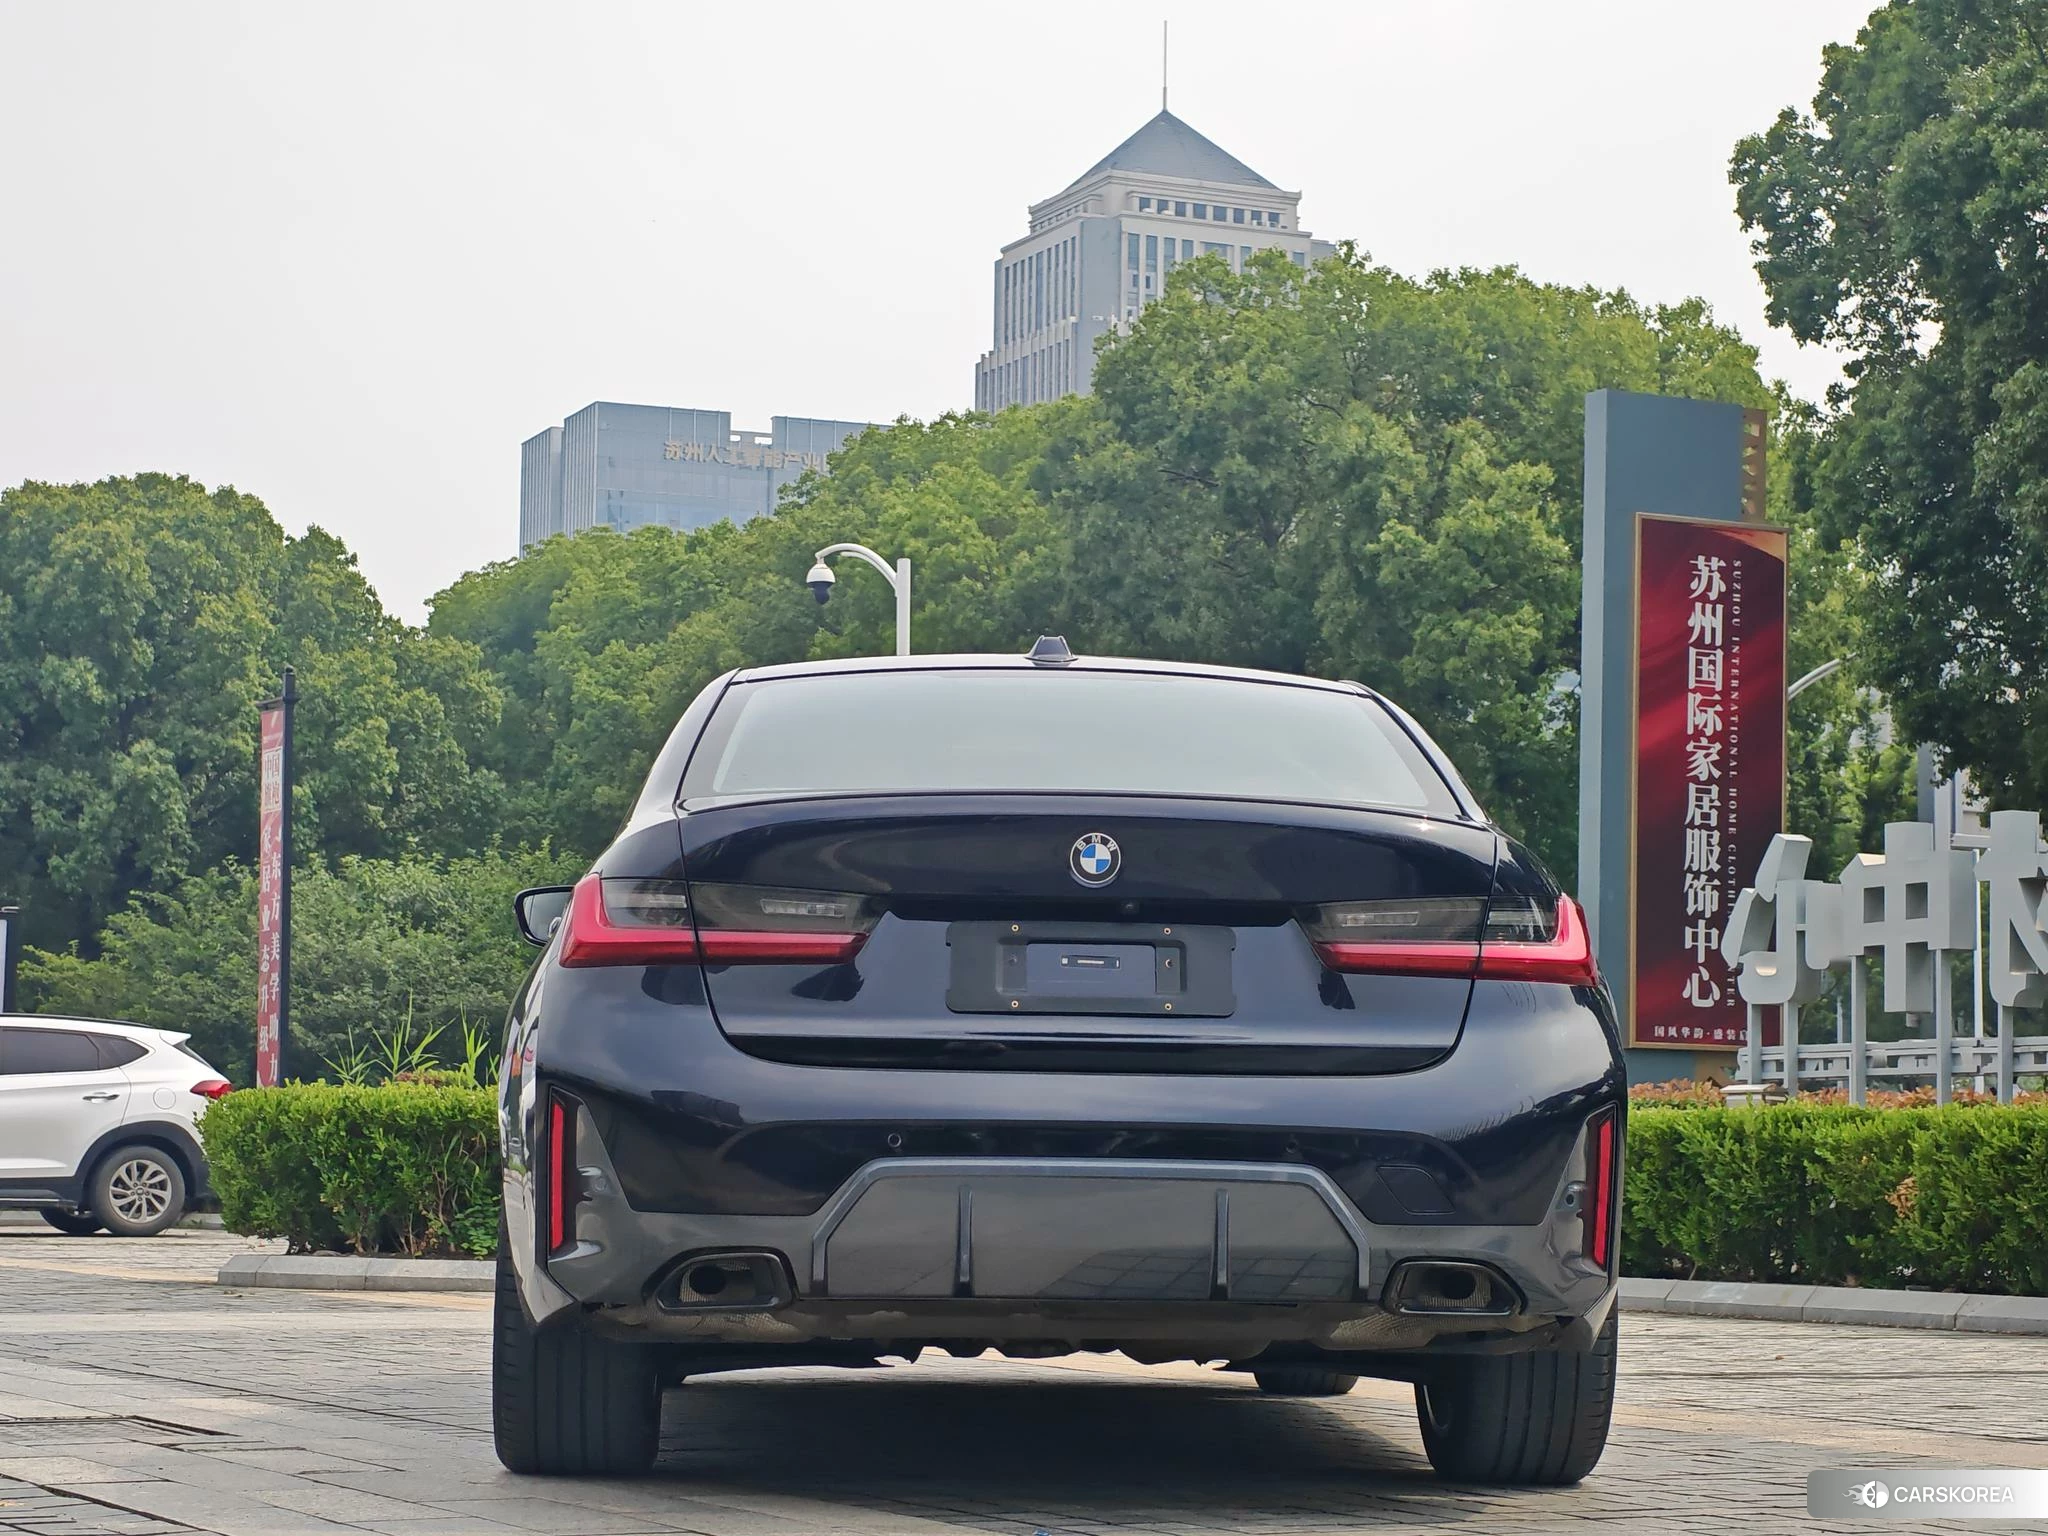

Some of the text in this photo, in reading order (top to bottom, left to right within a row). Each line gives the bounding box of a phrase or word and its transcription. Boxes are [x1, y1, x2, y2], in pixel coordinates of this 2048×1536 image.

[664, 440, 829, 473] 苏州人工智能产业
[1731, 559, 1742, 628] SUZHOU
[1728, 636, 1741, 779] INTERNATIONAL
[1682, 554, 1727, 1009] 苏州国际家居服饰中心
[1727, 787, 1738, 836] HOME
[1076, 833, 1117, 852] BMW
